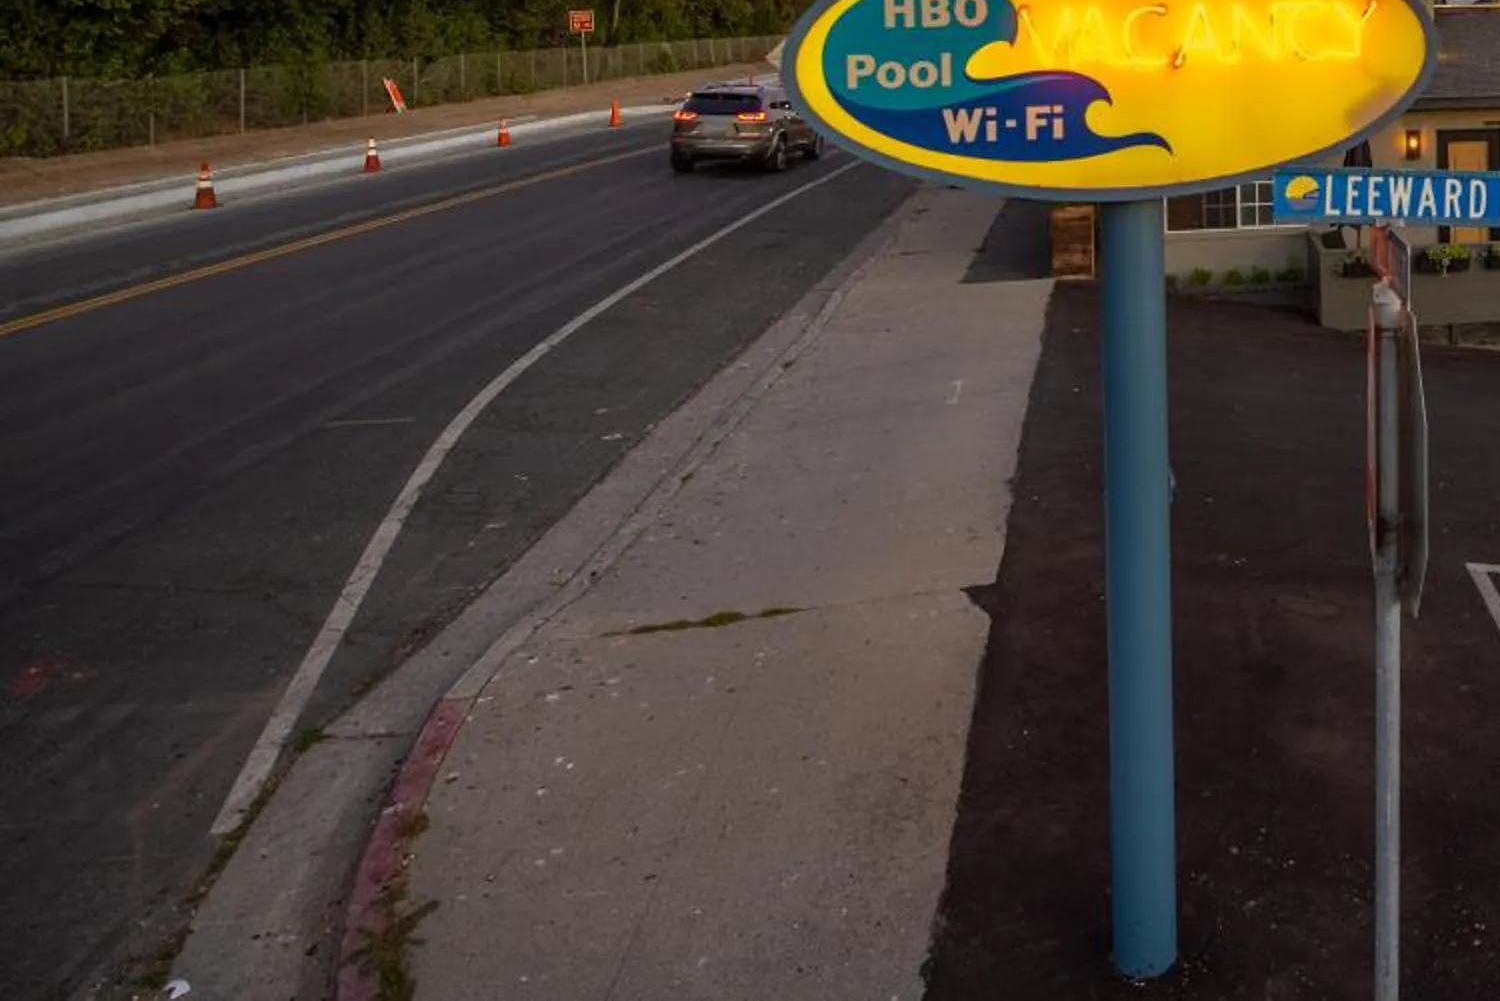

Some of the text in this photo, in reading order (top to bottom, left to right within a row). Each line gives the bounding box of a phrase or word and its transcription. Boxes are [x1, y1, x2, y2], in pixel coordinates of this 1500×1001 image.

[1018, 0, 1377, 68] VACANCY
[846, 52, 952, 90] Pool
[942, 104, 1065, 144] Wi-Fi
[1324, 174, 1488, 219] LEEWARD
